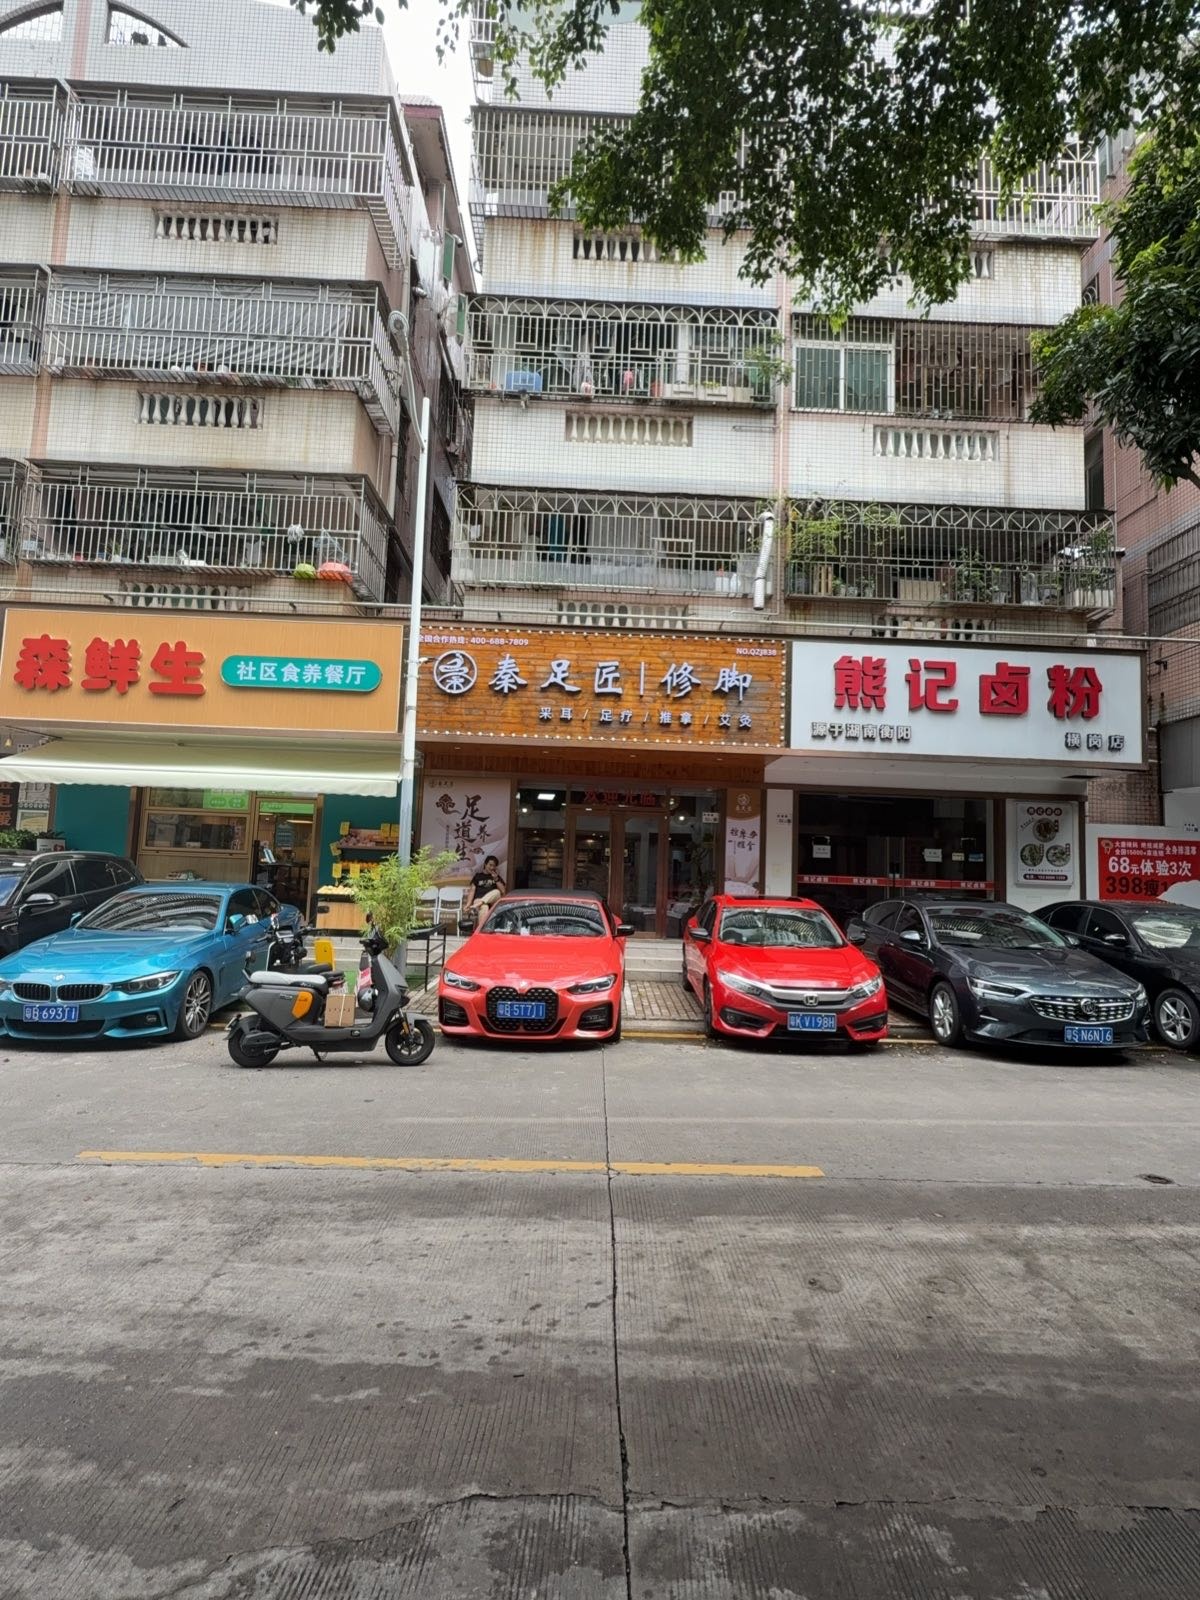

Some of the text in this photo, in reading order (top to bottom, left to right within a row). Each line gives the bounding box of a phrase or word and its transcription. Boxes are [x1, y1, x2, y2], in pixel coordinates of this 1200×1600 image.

[14, 634, 206, 697] 森鲜生
[237, 660, 367, 686] 社区食养餐厅
[834, 656, 1102, 719] 熊记卤粉
[811, 722, 912, 743] 源于湖南衡阳
[1065, 731, 1125, 752] 横岗店
[1108, 856, 1192, 877] 68元体验3次
